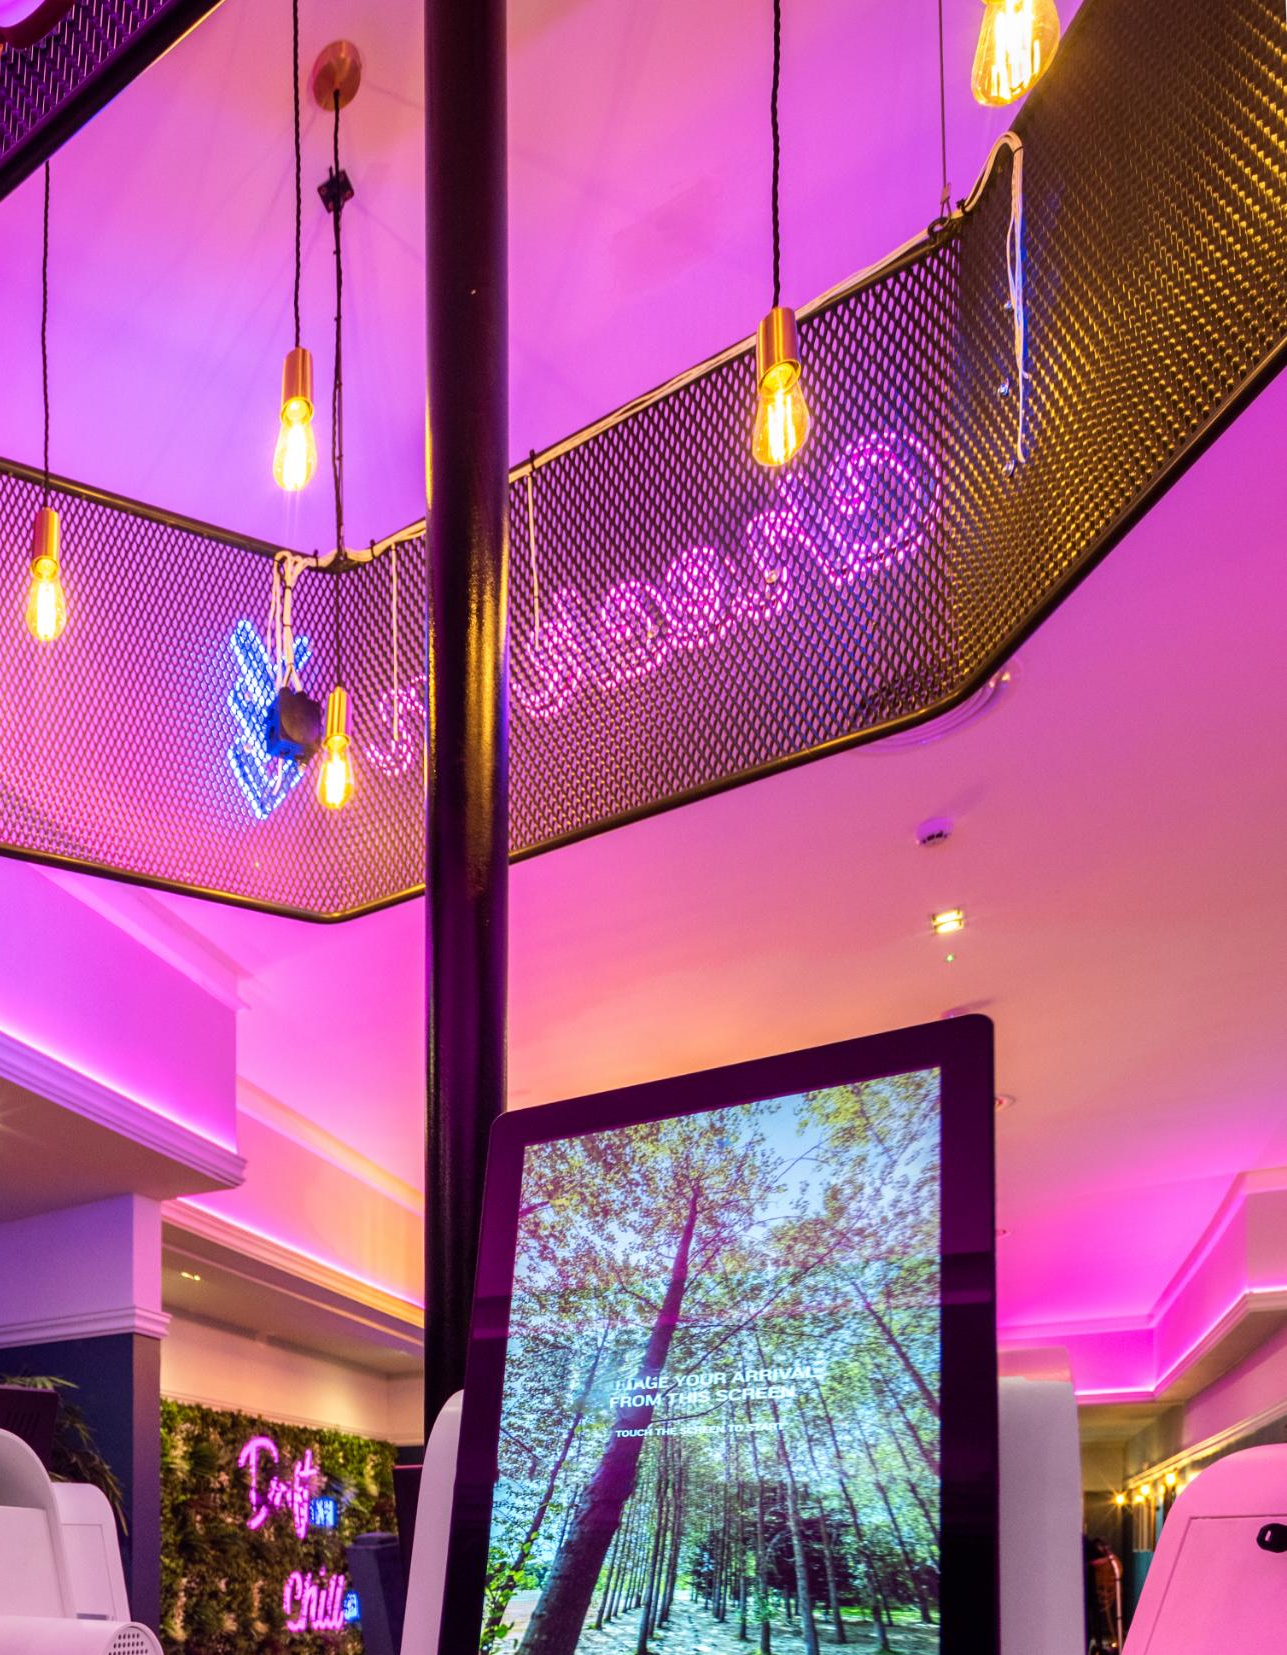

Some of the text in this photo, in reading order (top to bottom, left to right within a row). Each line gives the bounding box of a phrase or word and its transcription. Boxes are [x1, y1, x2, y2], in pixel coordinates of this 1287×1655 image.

[674, 1372, 726, 1388] YOUR
[731, 1365, 817, 1383] ARRIVAL
[609, 1386, 795, 1409] FROM THIS SCREEN
[616, 1428, 653, 1438] TOUCH
[655, 1427, 677, 1436] THE
[679, 1425, 726, 1435] SCREEN
[728, 1424, 743, 1433] TO
[282, 1564, 346, 1632] Chill
